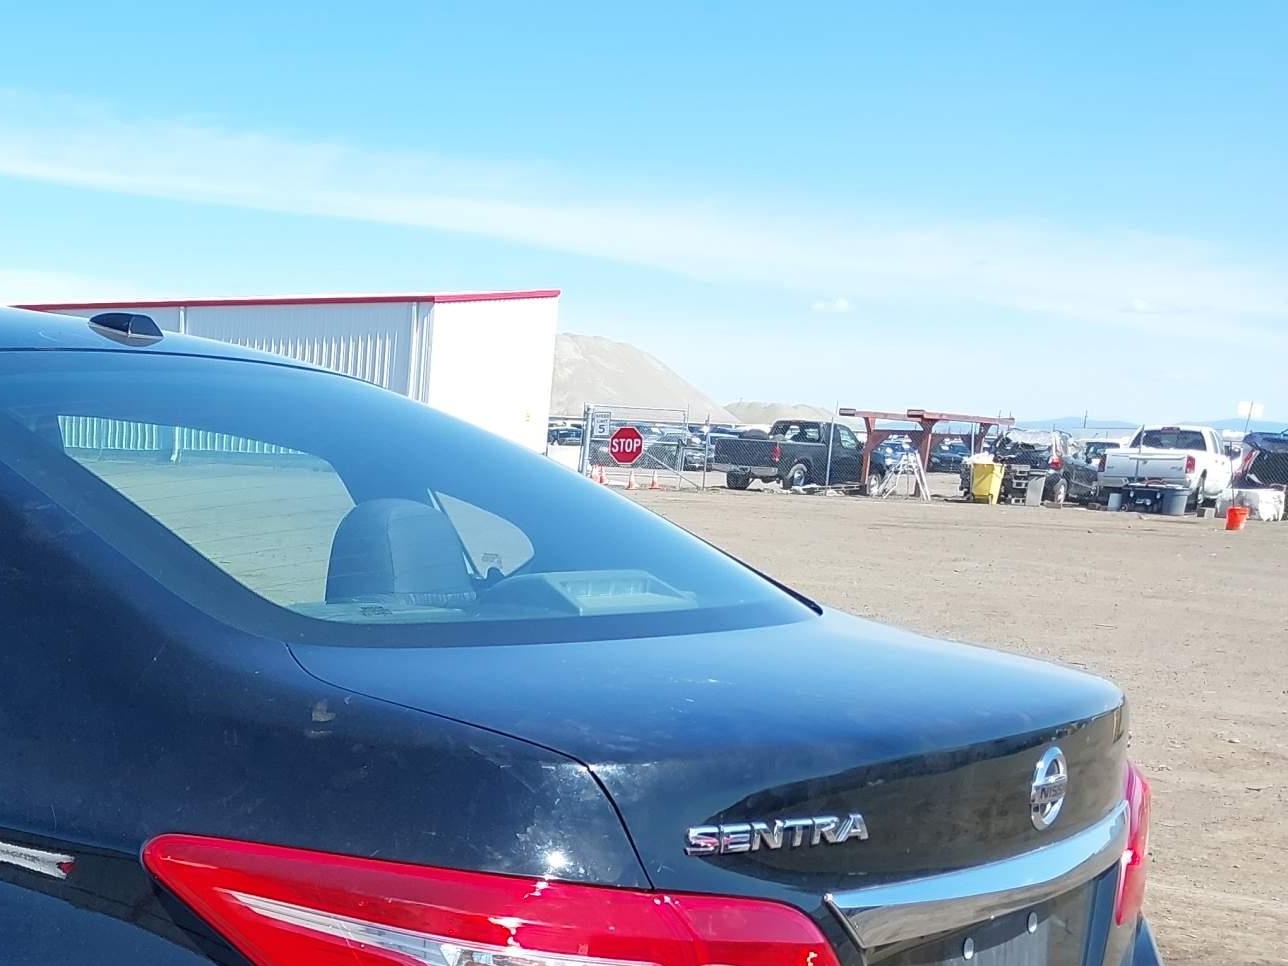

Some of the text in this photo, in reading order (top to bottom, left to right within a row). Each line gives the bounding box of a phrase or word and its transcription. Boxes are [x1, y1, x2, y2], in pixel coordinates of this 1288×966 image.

[598, 424, 606, 434] 5
[611, 438, 641, 452] STOP
[685, 813, 869, 857] SENTRA
